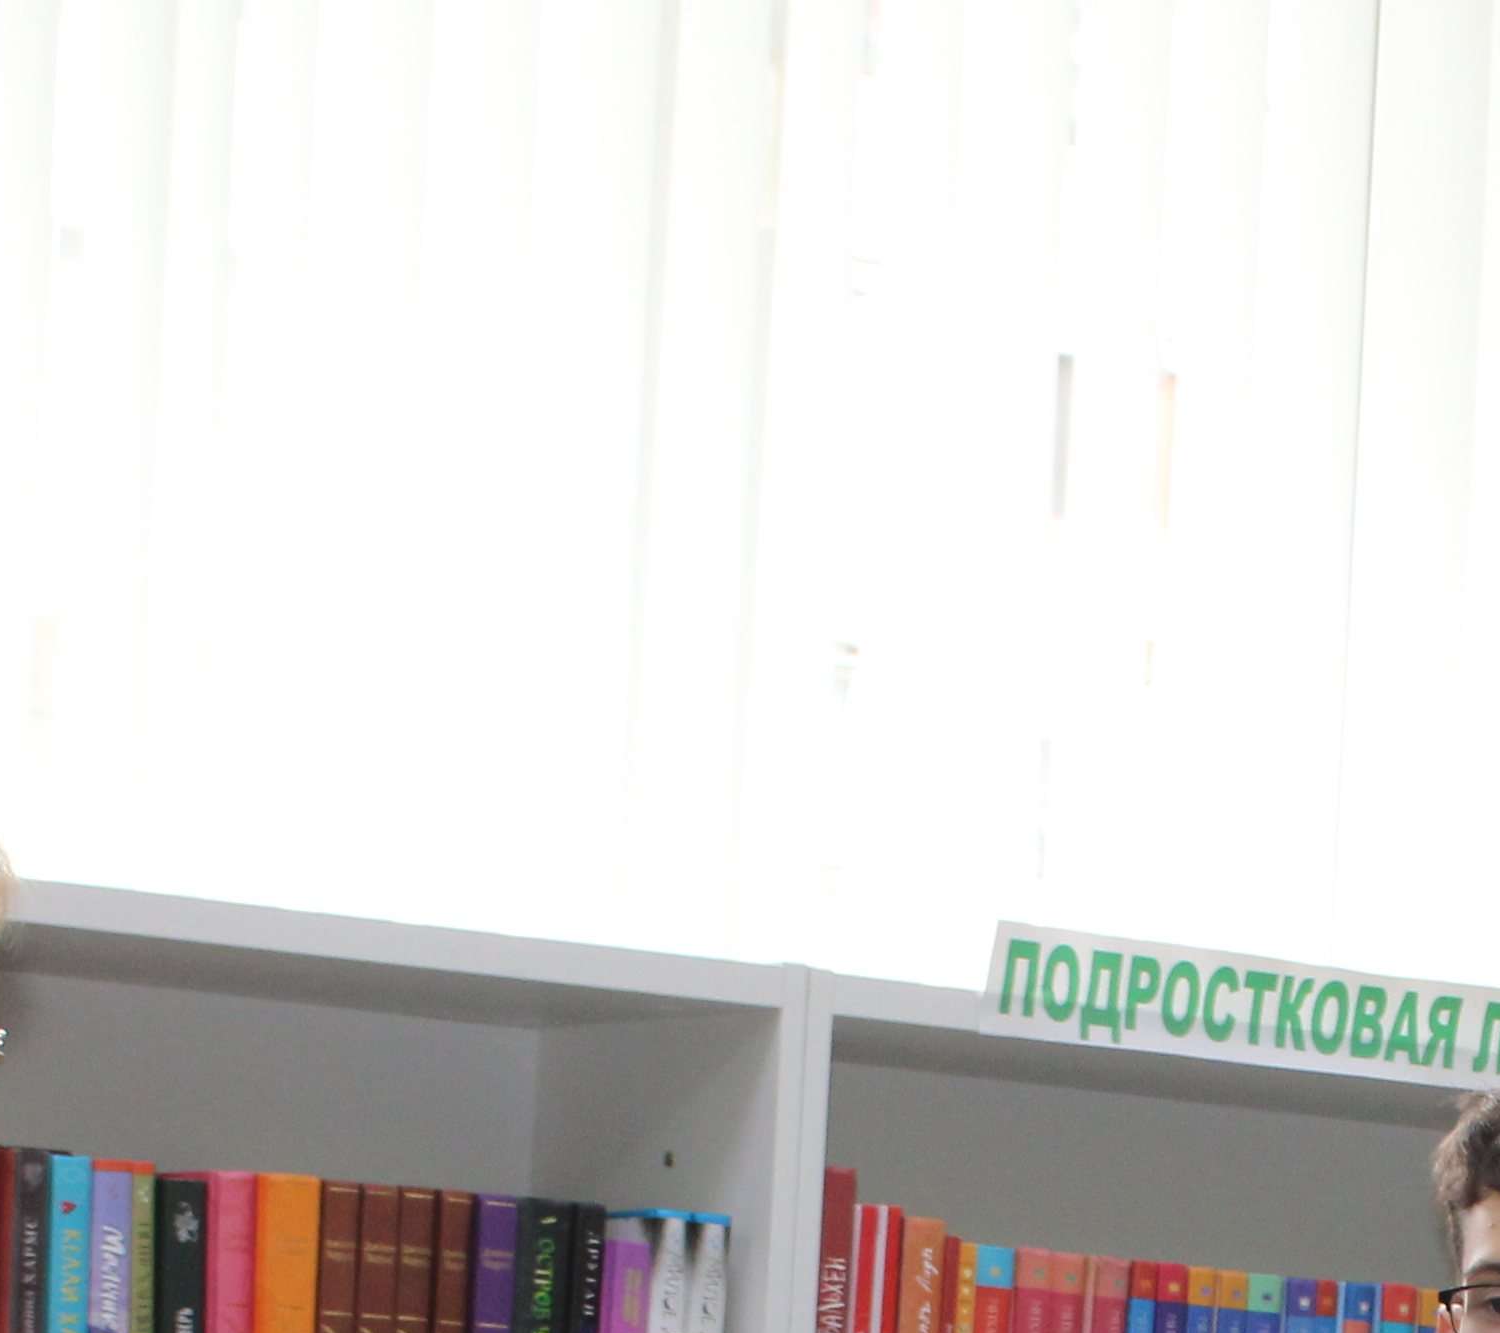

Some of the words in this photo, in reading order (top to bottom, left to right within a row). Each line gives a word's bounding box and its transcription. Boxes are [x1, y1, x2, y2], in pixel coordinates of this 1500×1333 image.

[1000, 940, 1462, 1067] ПОДРОСТКОВАЯ
[19, 1216, 39, 1286] ХАРМС
[60, 1228, 83, 1303] КЕЛЛИ
[530, 1237, 556, 1320] ОСТРОВ
